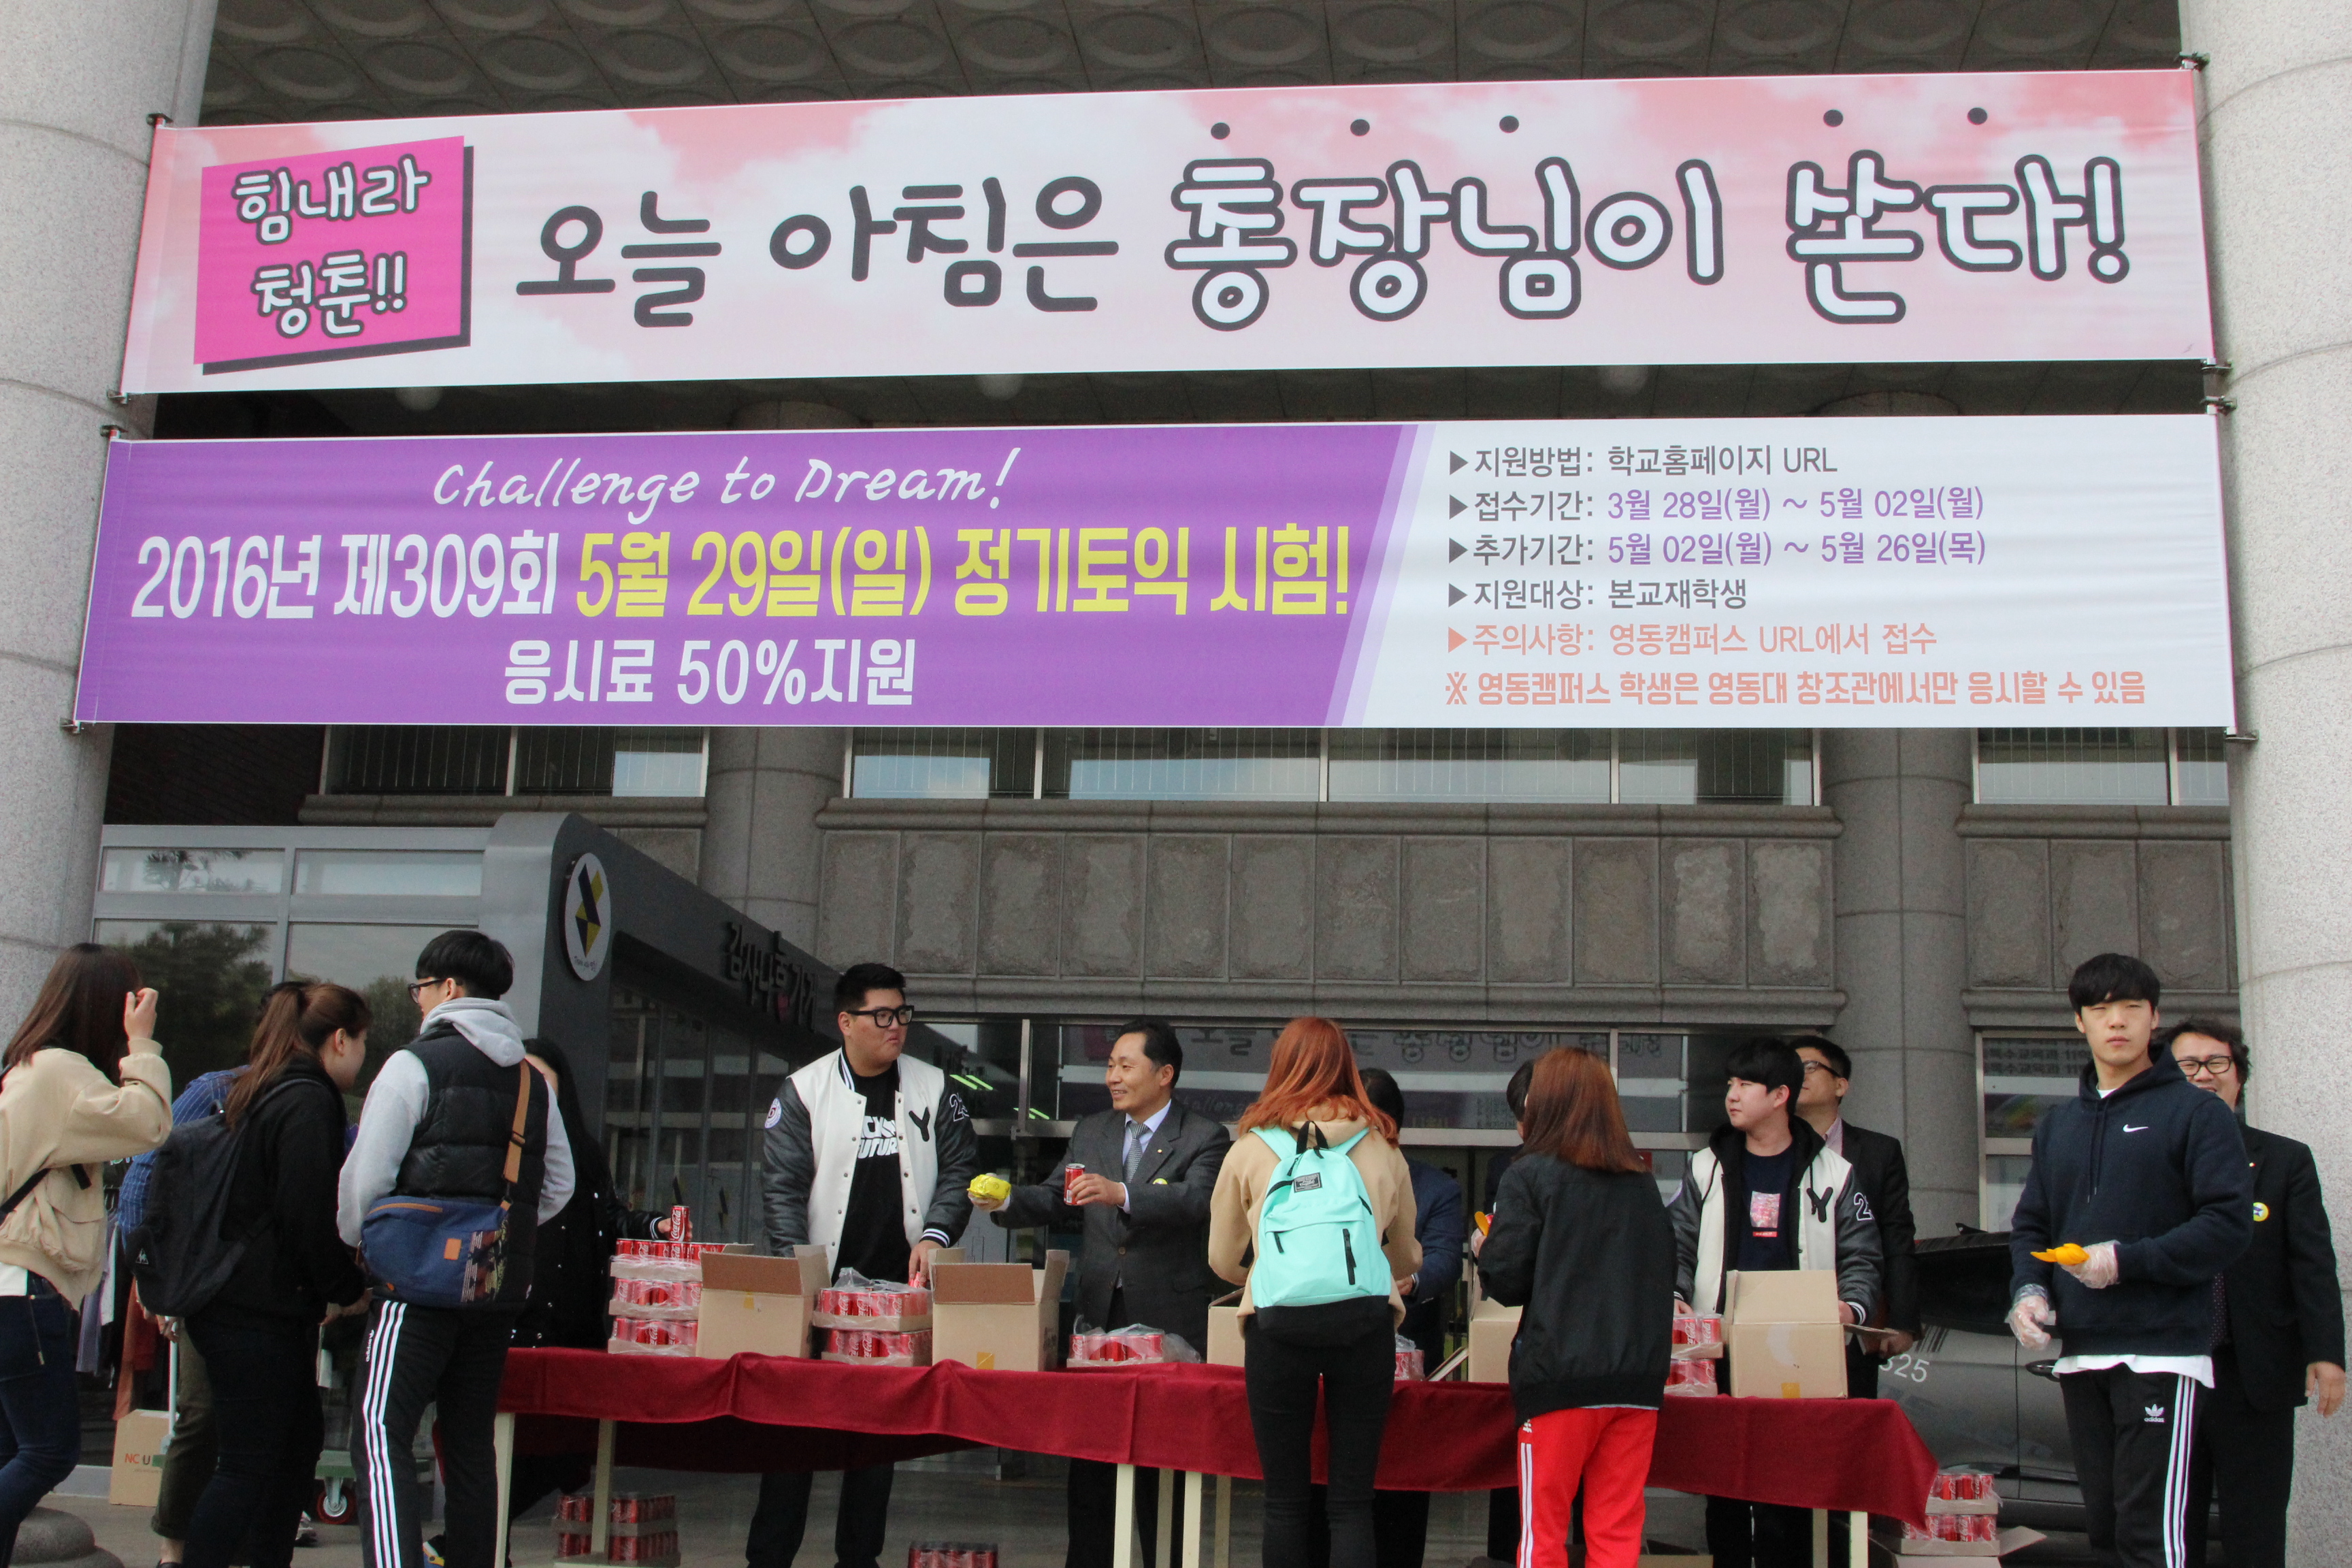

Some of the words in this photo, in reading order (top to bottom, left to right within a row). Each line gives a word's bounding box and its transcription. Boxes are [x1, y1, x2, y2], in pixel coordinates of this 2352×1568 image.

[231, 154, 431, 245] 힘내라
[517, 192, 721, 327] 오늘
[770, 177, 1118, 312] 아침은
[1165, 157, 1723, 331] 총장님이
[1786, 150, 2129, 324] 쏜다!
[250, 250, 407, 338] 청춘!!
[1475, 447, 1592, 477] 지원방법:
[1609, 445, 1770, 476] 학교홈페이지
[1784, 448, 1837, 472] URL
[434, 458, 700, 525] Challenge
[721, 456, 775, 504] to
[795, 448, 1021, 509] Dream!
[1475, 491, 1592, 521] 접수기간:
[1609, 490, 1650, 520] 3월
[1664, 488, 1769, 521] 28일(월)
[1821, 488, 1862, 518] 5월
[1875, 487, 1982, 519] 02일(월)
[132, 535, 322, 619] 2016년
[333, 529, 559, 616] 제309회
[577, 532, 670, 617] 5월
[687, 526, 931, 617] 29일(일)
[955, 527, 1189, 616] 정기토익
[1211, 523, 1349, 615] 시험!
[1473, 535, 1592, 566] 추가기간:
[1609, 534, 1650, 564] 5월
[1663, 532, 1771, 566] 02일(월)
[1822, 532, 1863, 564] 5월
[1878, 531, 1984, 564] 26일(목)
[1475, 580, 1592, 609] 지원대상:
[1609, 579, 1746, 609] 본교재학생
[1473, 624, 1594, 656] 주의사항:
[1610, 623, 1748, 655] 영동캠퍼스
[1760, 623, 1869, 654] URL에서
[1883, 623, 1937, 654] 접수
[505, 640, 654, 704] 응시료
[678, 639, 915, 705] 50%지원
[1479, 673, 1611, 705] 영동캠퍼스
[1620, 672, 1699, 705] 학생은
[1709, 672, 1787, 704] 영동대
[1797, 671, 1959, 704] 창조관에서만
[1968, 670, 2048, 704] 응시할
[2059, 672, 2083, 703] 수
[2092, 672, 2145, 704] 있음
